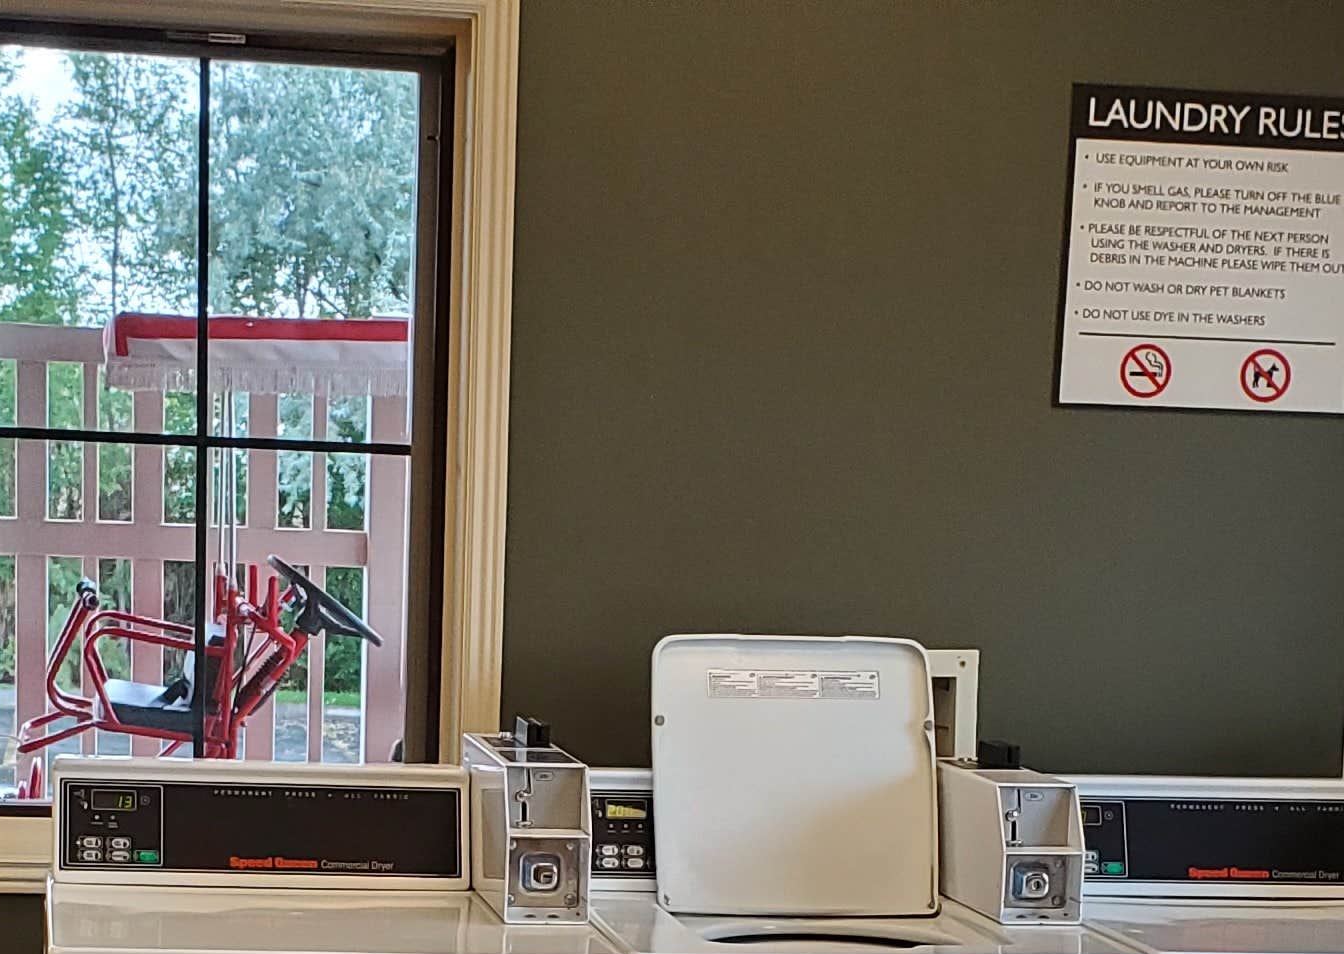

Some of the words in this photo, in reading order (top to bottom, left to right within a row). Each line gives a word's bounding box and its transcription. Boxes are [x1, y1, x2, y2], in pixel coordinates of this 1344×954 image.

[1088, 96, 1252, 135] LAUNDRY
[1096, 153, 1117, 165] USE
[1119, 154, 1184, 168] EQUIPMENT
[1185, 157, 1201, 169] AT
[1202, 158, 1233, 171] YOUR
[1235, 160, 1264, 172] OWN
[1267, 161, 1289, 173] RISK
[1094, 183, 1103, 193] IF
[1106, 183, 1129, 195] YOU
[1132, 184, 1164, 197] SMELL
[1194, 187, 1231, 200] PLEASE
[1234, 189, 1264, 201] TURN
[1267, 191, 1289, 202] OFF
[1291, 192, 1312, 204] THE
[1315, 193, 1341, 205] BLUE
[1094, 197, 1126, 209] KNOB
[1128, 200, 1154, 211] AND
[1156, 201, 1198, 213] REPORT
[1200, 203, 1217, 214] TO
[1220, 204, 1241, 215] THE
[1244, 205, 1321, 219] MANAGEMENT
[1088, 223, 1126, 236] PLEASE
[1129, 225, 1142, 236] BE
[1144, 225, 1209, 239] RESPECTFUL
[1212, 229, 1227, 240] OF
[1231, 230, 1251, 241] THE
[1254, 231, 1285, 243] NEXT
[1287, 233, 1329, 244] PERSON
[1091, 238, 1125, 250] USING
[1128, 240, 1149, 250] THE
[1152, 241, 1196, 252] WASHER
[1198, 243, 1223, 254] AND
[1226, 244, 1268, 257] DRYERS.
[1273, 247, 1283, 257] IF
[1286, 248, 1318, 259] THERE
[1322, 249, 1330, 260] IS
[1090, 252, 1126, 265] DEBRIS
[1129, 255, 1140, 265] IN
[1144, 255, 1165, 266] THE
[1168, 256, 1218, 269] MACHINE
[1221, 258, 1258, 270] PLEASE
[1261, 260, 1287, 272] WIPE
[1289, 262, 1320, 273] THEM
[1084, 280, 1102, 291] DO
[1105, 282, 1131, 293] NOT
[1134, 283, 1164, 294] WASH
[1167, 284, 1183, 295] OR
[1185, 285, 1207, 296] DRY
[1210, 286, 1229, 297] PET
[1231, 287, 1286, 300] BLANKETS
[1082, 308, 1100, 319] DO
[1103, 309, 1128, 321] NOT
[1131, 311, 1150, 321] USE
[1154, 311, 1175, 323] DYE
[1178, 313, 1189, 323] IN
[1192, 313, 1213, 324] THE
[1217, 313, 1266, 326] WASHERS
[118, 795, 133, 809] 13
[229, 856, 273, 869] Speed
[320, 859, 370, 870] Commercial
[371, 860, 395, 871] Dryer
[1318, 870, 1340, 880] Dryer
